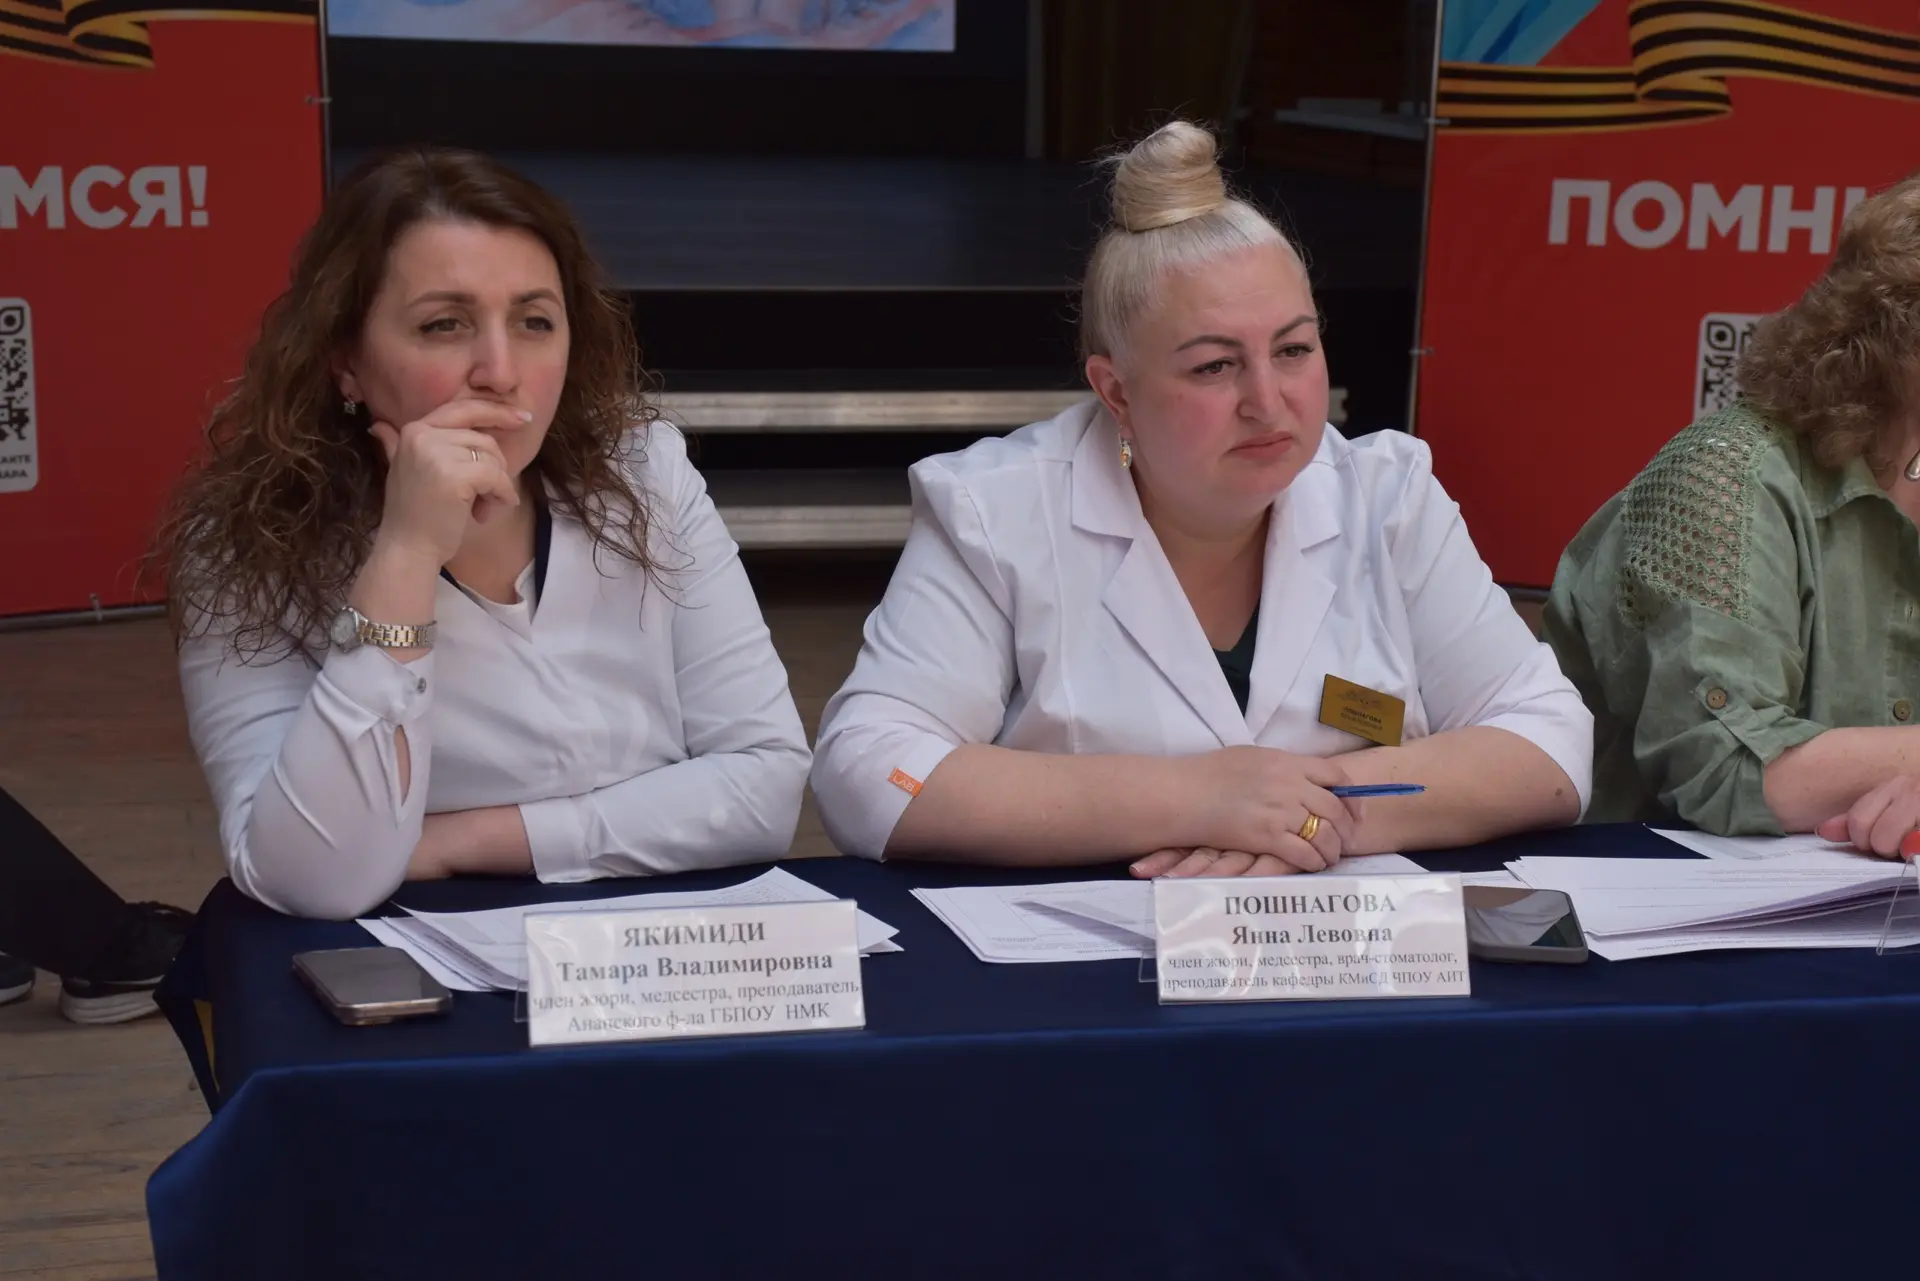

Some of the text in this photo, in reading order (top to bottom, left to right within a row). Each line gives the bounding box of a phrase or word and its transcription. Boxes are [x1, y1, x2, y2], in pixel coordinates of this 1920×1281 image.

[1548, 179, 1867, 254] ПОМН
[1224, 893, 1396, 915] ПОШНАГОВА
[623, 922, 766, 948] ЯКИМИДИ
[1232, 924, 1393, 945] Янна Левовна
[556, 954, 833, 985] Тамара Владимировна
[1168, 952, 1458, 971] член жюри, медсестра, врач-стоматолог,
[1272, 972, 1334, 989] кафедры
[1392, 971, 1433, 984] ЧПОУ
[533, 994, 574, 1010] член
[640, 987, 732, 1005] медсестра,
[737, 980, 859, 1001] преподаватель
[666, 1010, 705, 1030] ф-ла
[710, 1005, 775, 1024] ГБПОУ
[786, 1002, 830, 1020] НМК
